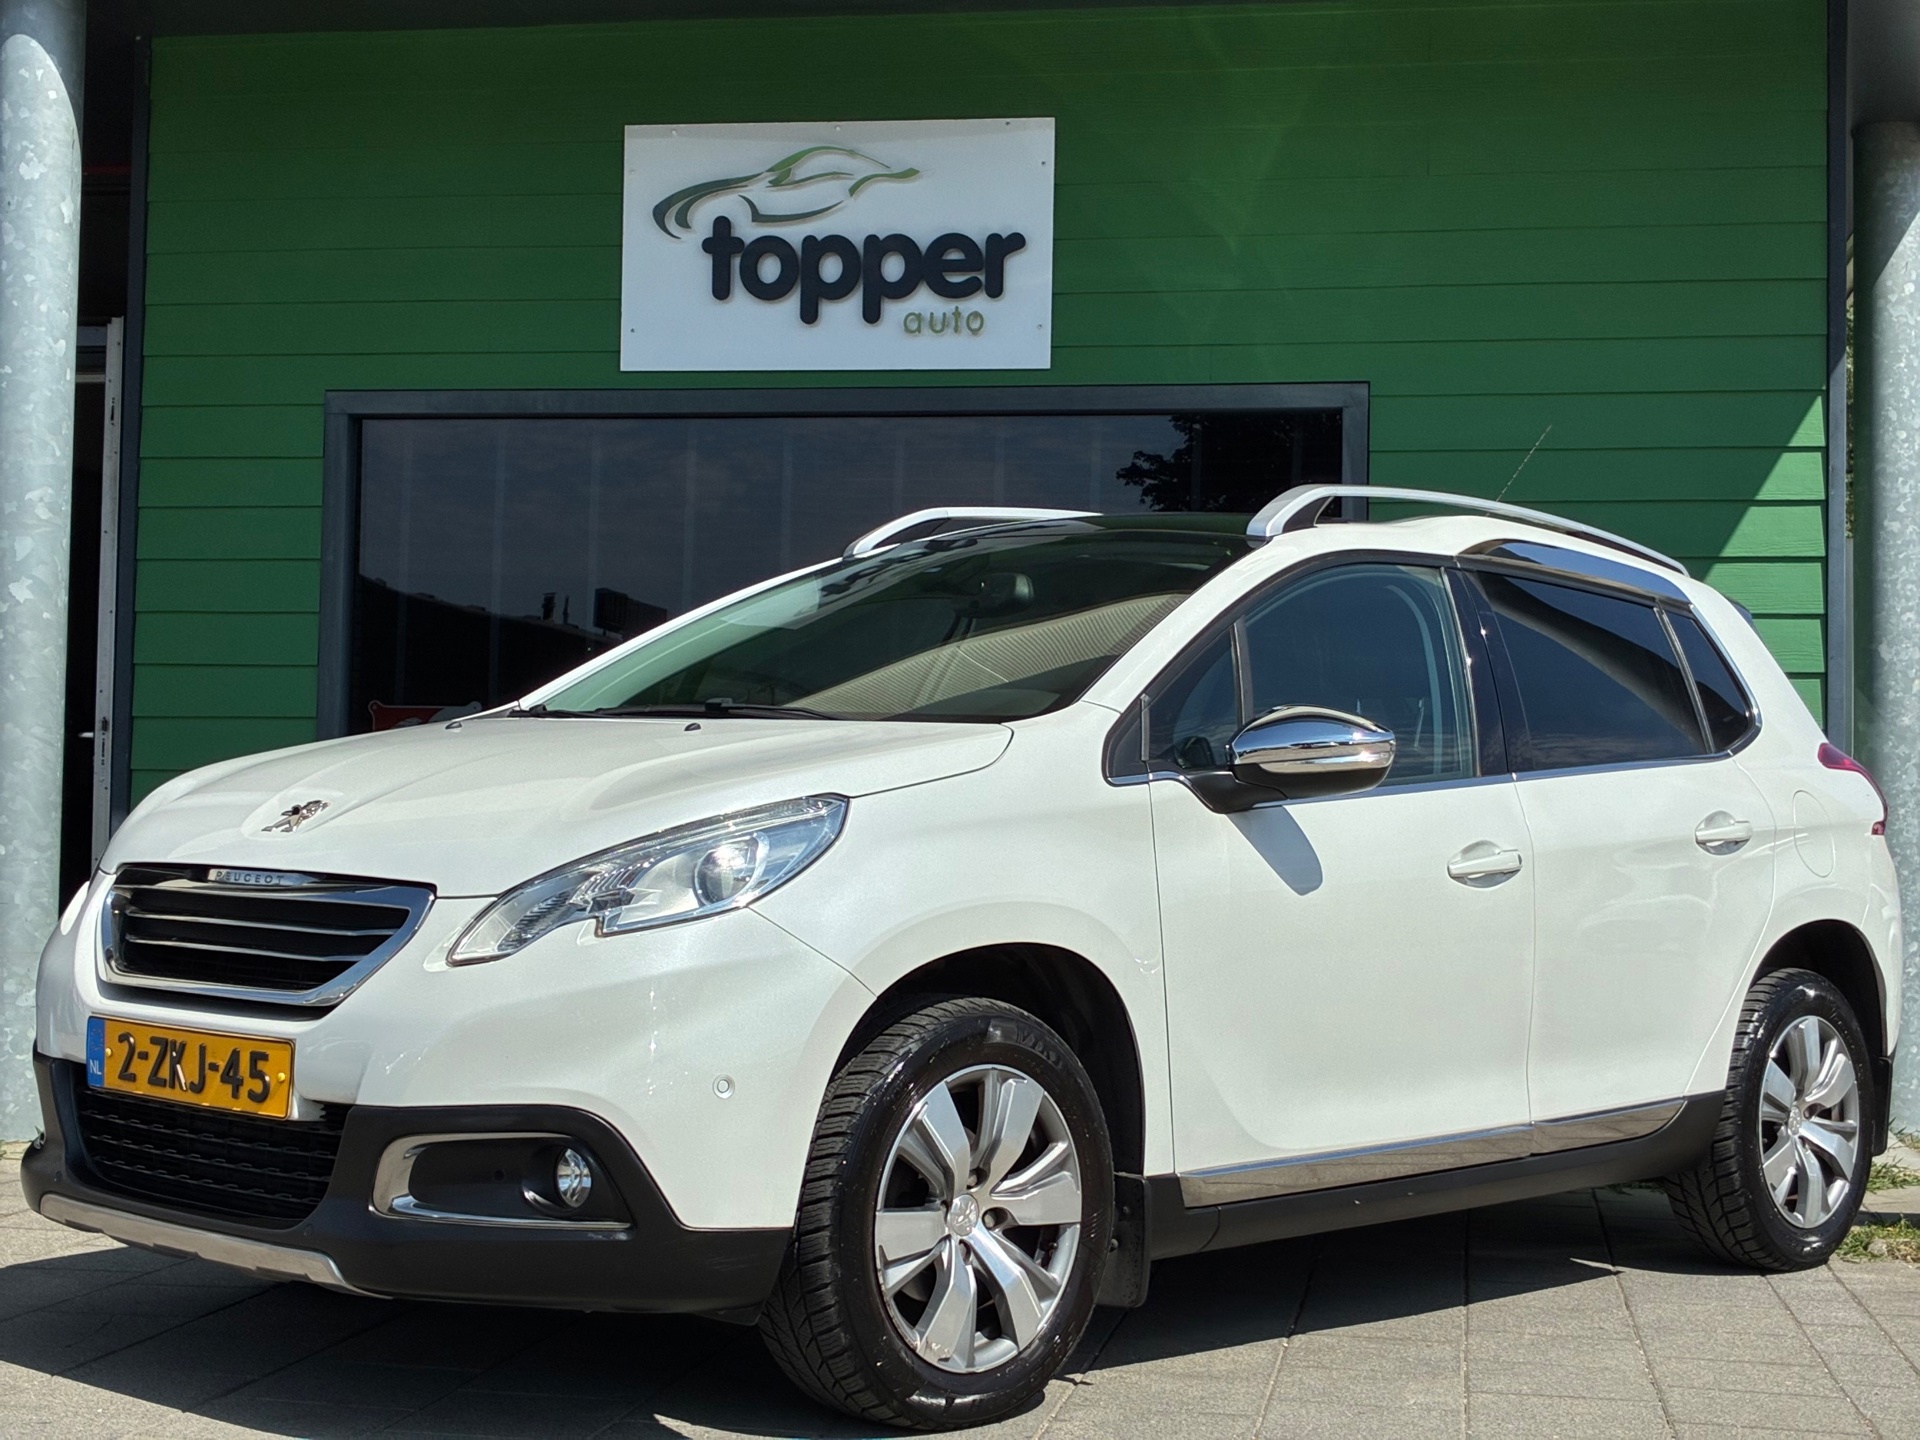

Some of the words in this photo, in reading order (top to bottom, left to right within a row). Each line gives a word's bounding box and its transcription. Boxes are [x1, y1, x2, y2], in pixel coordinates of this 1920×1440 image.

[702, 215, 1026, 325] topper
[903, 305, 985, 334] auto
[215, 870, 284, 886] PEUGEOT
[89, 1058, 102, 1076] NL
[117, 1031, 271, 1104] 2-ZKJ-45
